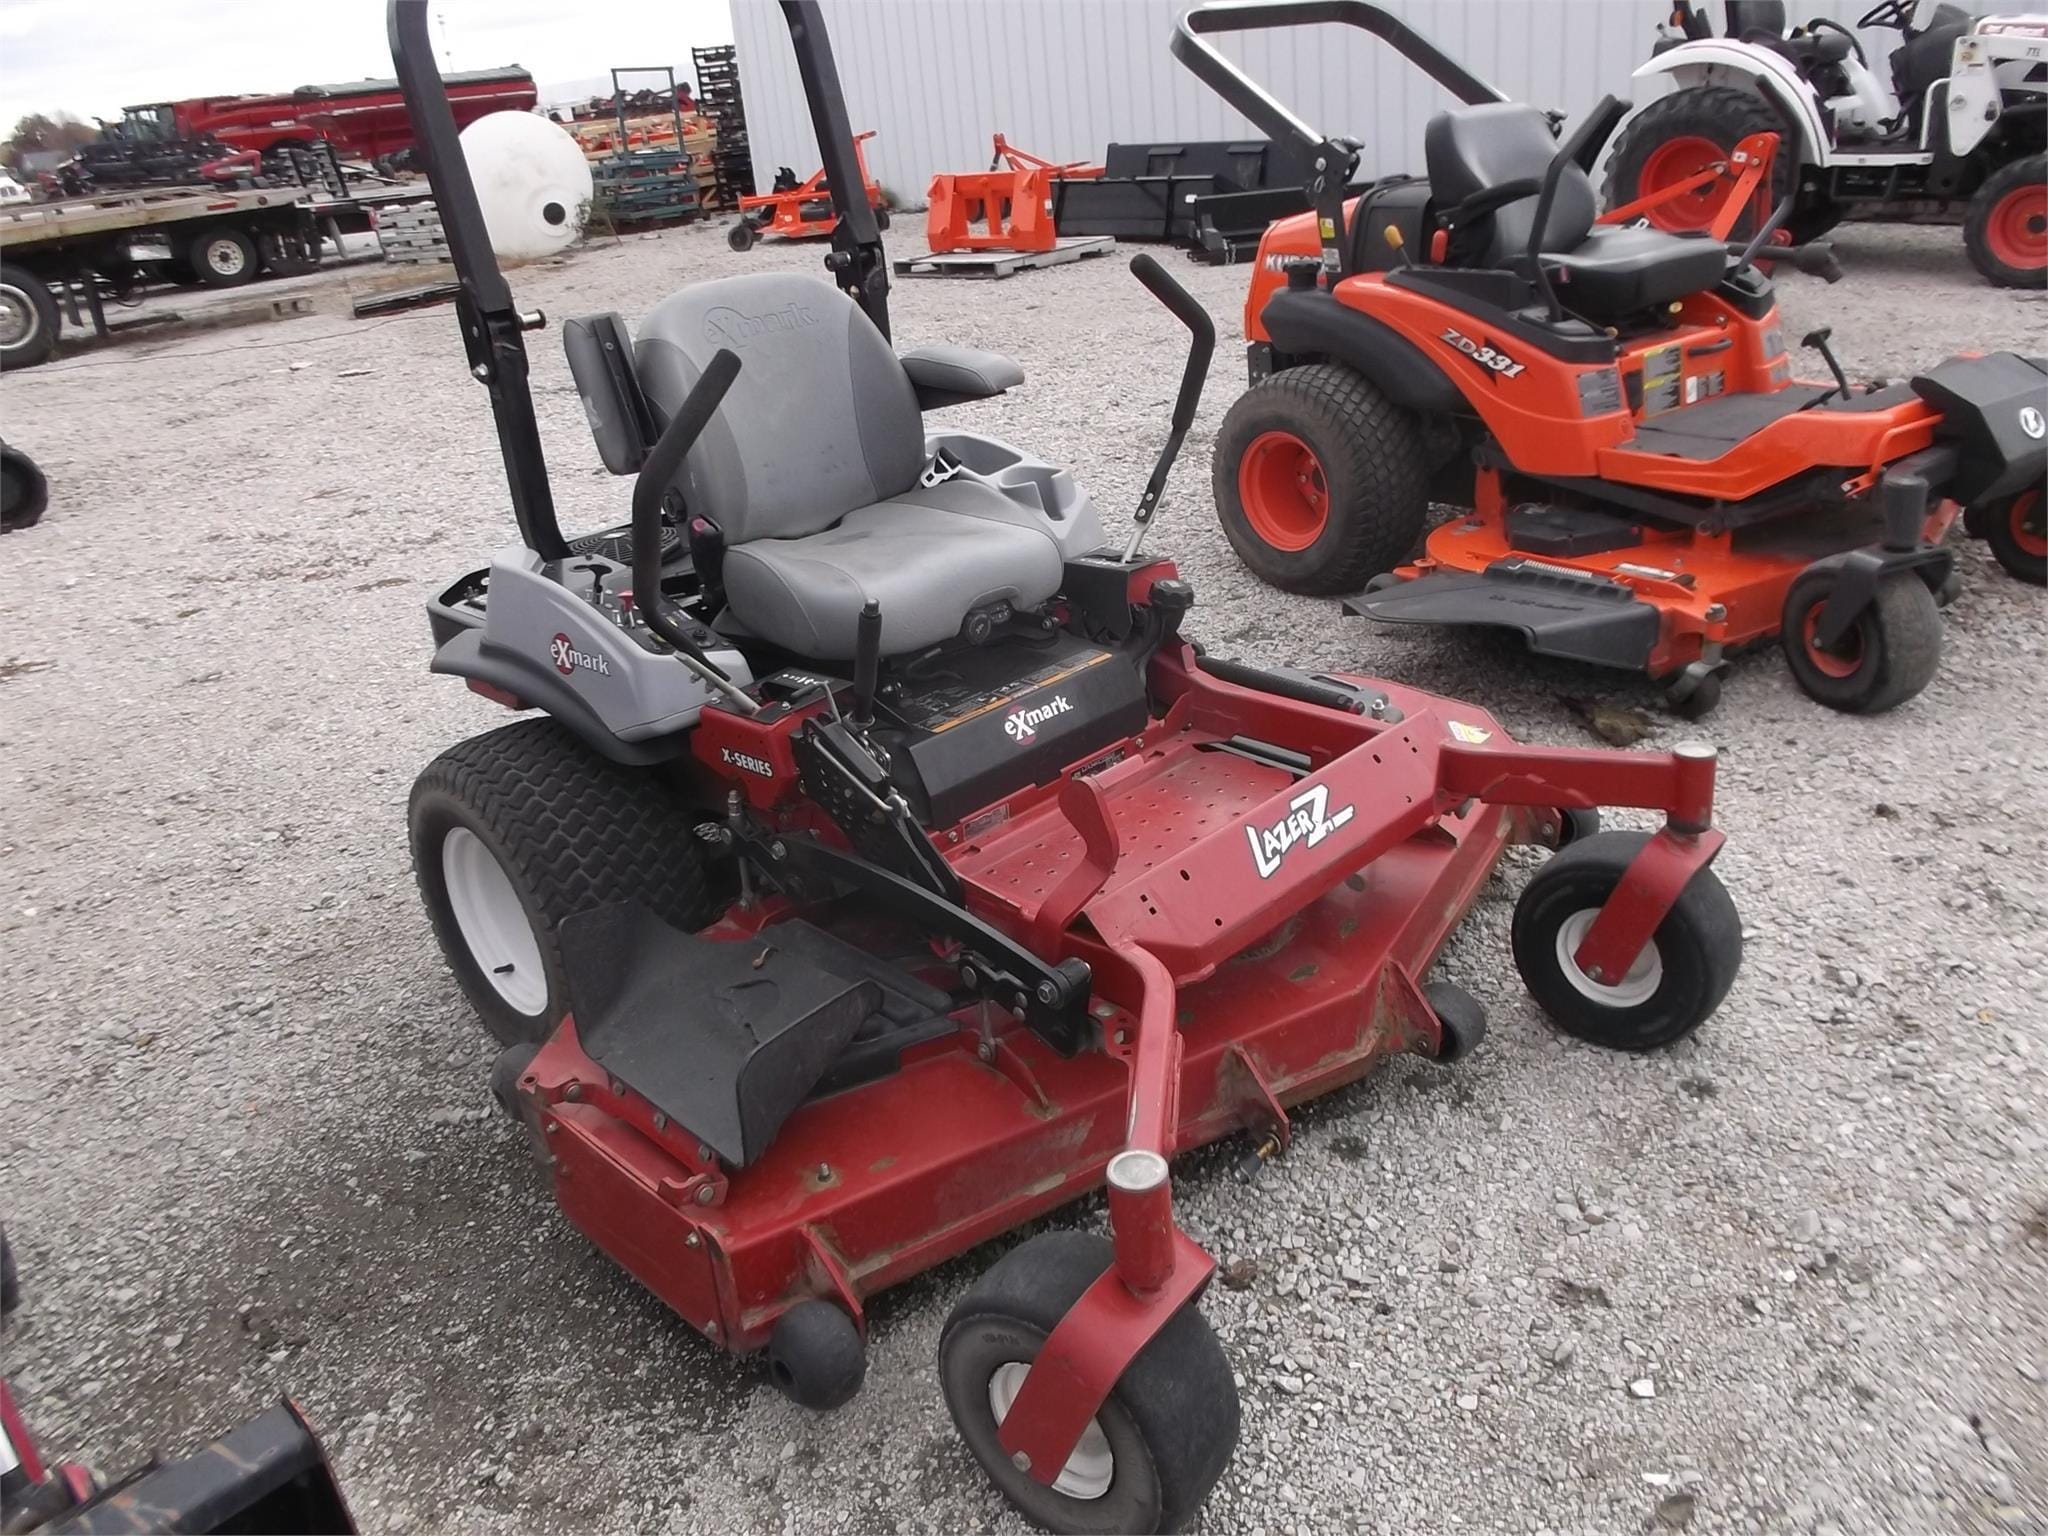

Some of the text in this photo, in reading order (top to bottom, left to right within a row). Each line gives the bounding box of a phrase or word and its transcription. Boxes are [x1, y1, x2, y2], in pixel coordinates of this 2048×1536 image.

[1440, 327, 1525, 378] ZD331
[550, 639, 609, 675] eXmark
[721, 747, 773, 777] X-SERIES
